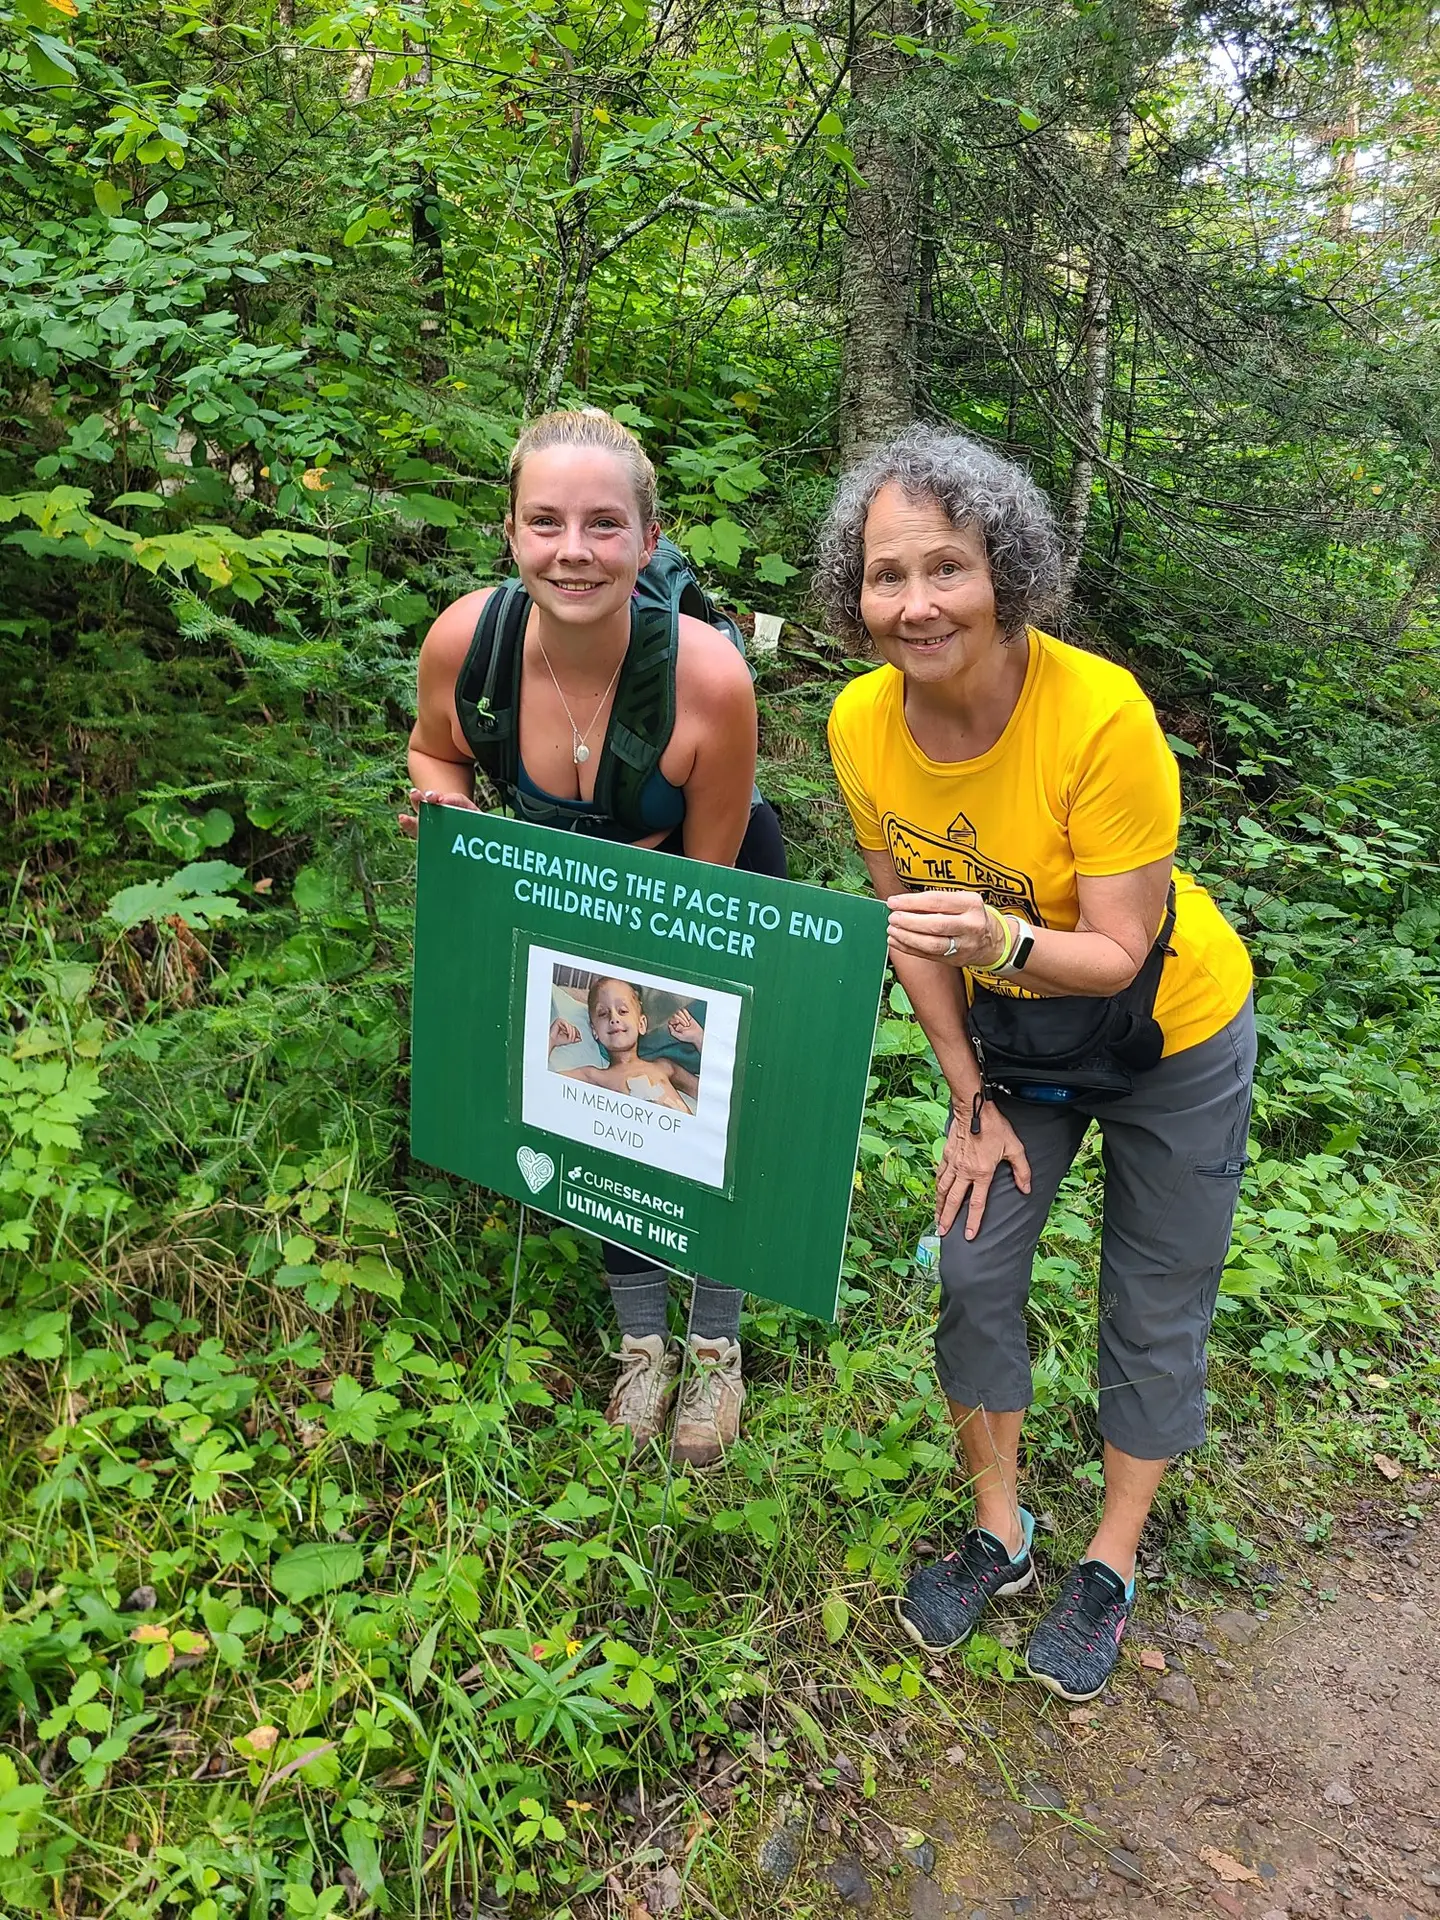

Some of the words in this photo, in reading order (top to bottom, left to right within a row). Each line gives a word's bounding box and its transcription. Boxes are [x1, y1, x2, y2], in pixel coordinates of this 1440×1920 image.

[451, 833, 618, 892] ACCELERATING
[625, 872, 666, 904] THE
[672, 884, 739, 922] PACE
[748, 901, 781, 930] TO
[789, 912, 843, 945] END
[923, 860, 956, 879] THE
[963, 860, 1014, 890] TRAIL
[980, 890, 1027, 908] CANCER
[514, 878, 642, 930] CHILDREN'S
[650, 912, 755, 958] CANCER
[562, 1084, 577, 1102] IN
[582, 1092, 653, 1126] MEMORY
[658, 1115, 681, 1133] OF
[593, 1120, 644, 1149] DAVID
[583, 1172, 685, 1219] CURESEARCH
[566, 1191, 643, 1235] ULTIMATE
[648, 1223, 688, 1253] HIKE
